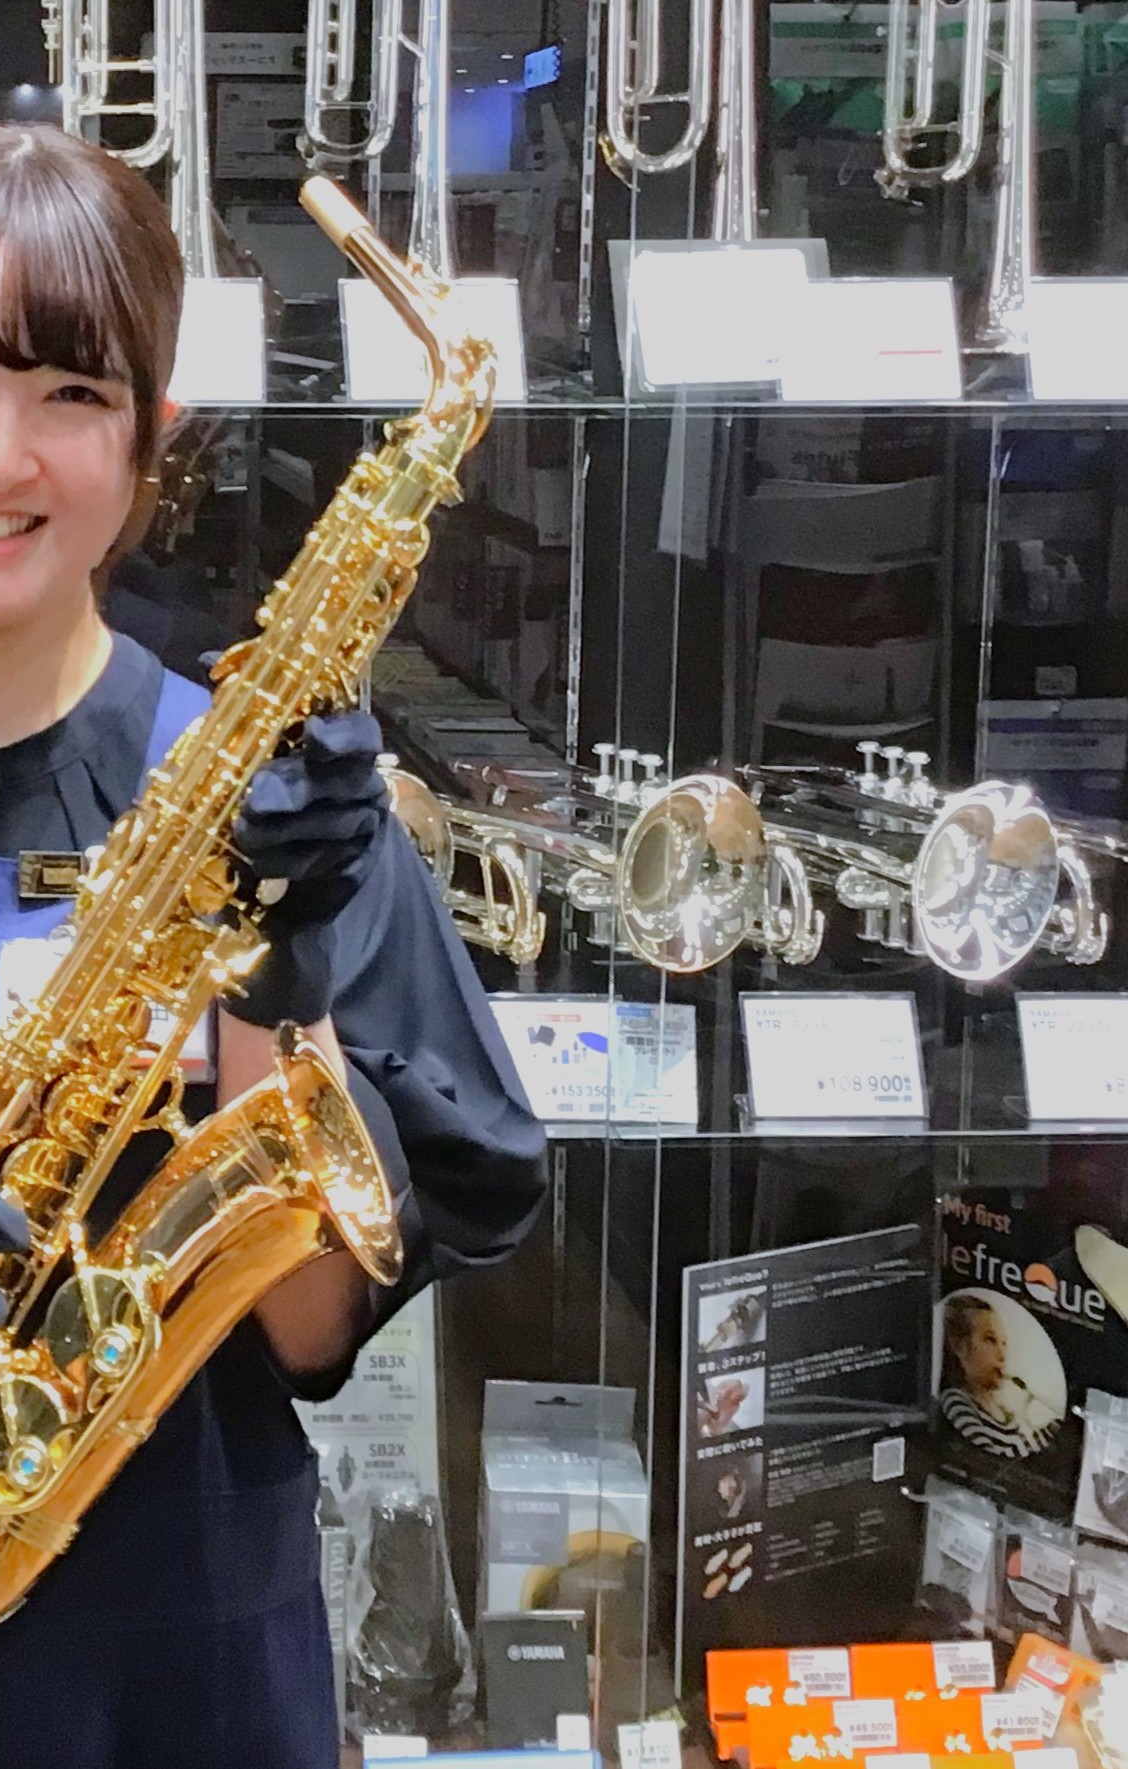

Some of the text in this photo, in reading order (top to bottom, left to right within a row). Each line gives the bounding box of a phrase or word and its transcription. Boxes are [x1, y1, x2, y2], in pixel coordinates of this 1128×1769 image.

[943, 1192, 1012, 1235] My first
[369, 1355, 407, 1369] SB3X
[368, 1443, 407, 1457] SB2X
[521, 1645, 566, 1660] YAMAHA
